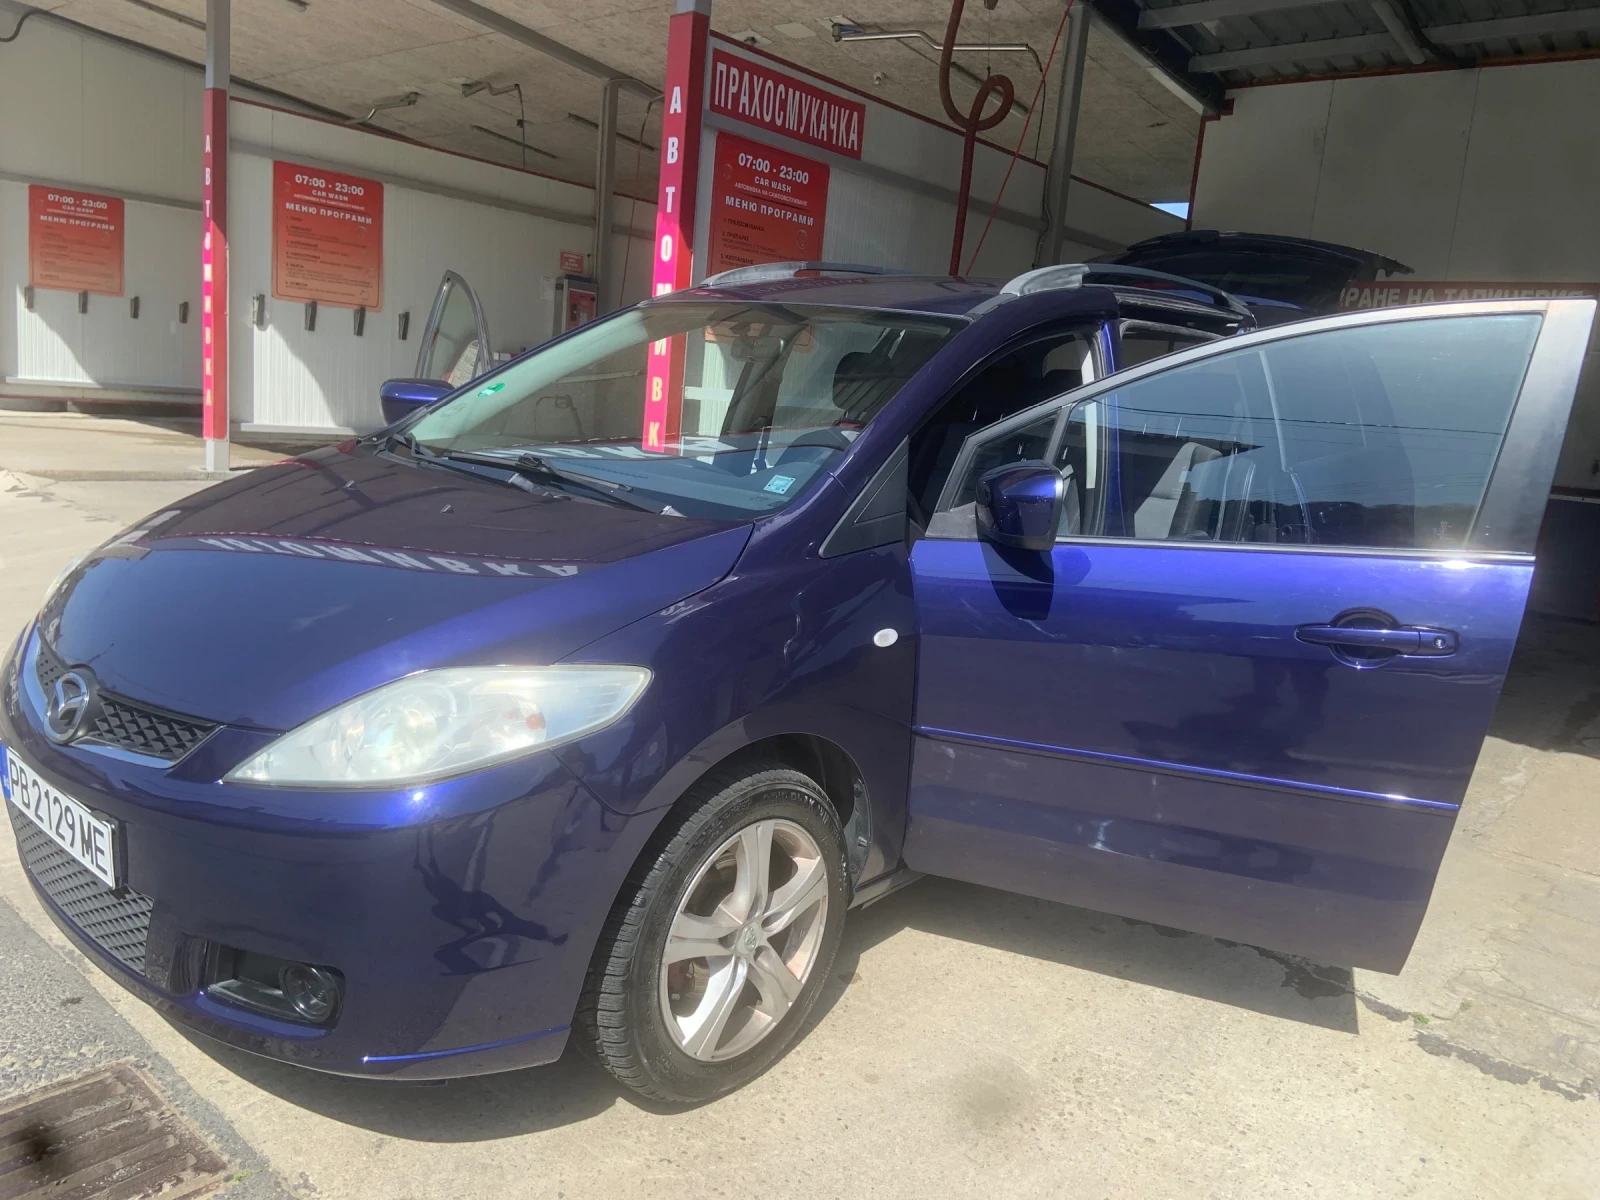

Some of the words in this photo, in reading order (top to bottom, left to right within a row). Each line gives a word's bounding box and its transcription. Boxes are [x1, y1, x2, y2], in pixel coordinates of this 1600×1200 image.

[714, 61, 859, 151] ПРАХОСМУКАЧКА
[738, 152, 770, 173] 07:00
[779, 165, 809, 185] 23:00
[295, 174, 326, 188] 07:00
[335, 182, 364, 196] 23:00
[312, 189, 327, 197] CAR
[328, 192, 349, 202] WASH
[754, 176, 769, 187] CAR
[771, 180, 792, 193] WASH
[47, 193, 74, 204] 07:00
[82, 198, 108, 209] 23:00
[725, 195, 757, 212] МЕНЮ
[760, 204, 814, 227] ПРОГРАМИ
[40, 215, 67, 224] МЕНЮ
[69, 219, 115, 231] ПРОГРАМИ
[285, 202, 317, 215] МЕНЮ
[320, 208, 372, 225] ПРОГРАМИ
[203, 135, 213, 406] АВТОМИВКА
[1406, 287, 1435, 304] НА
